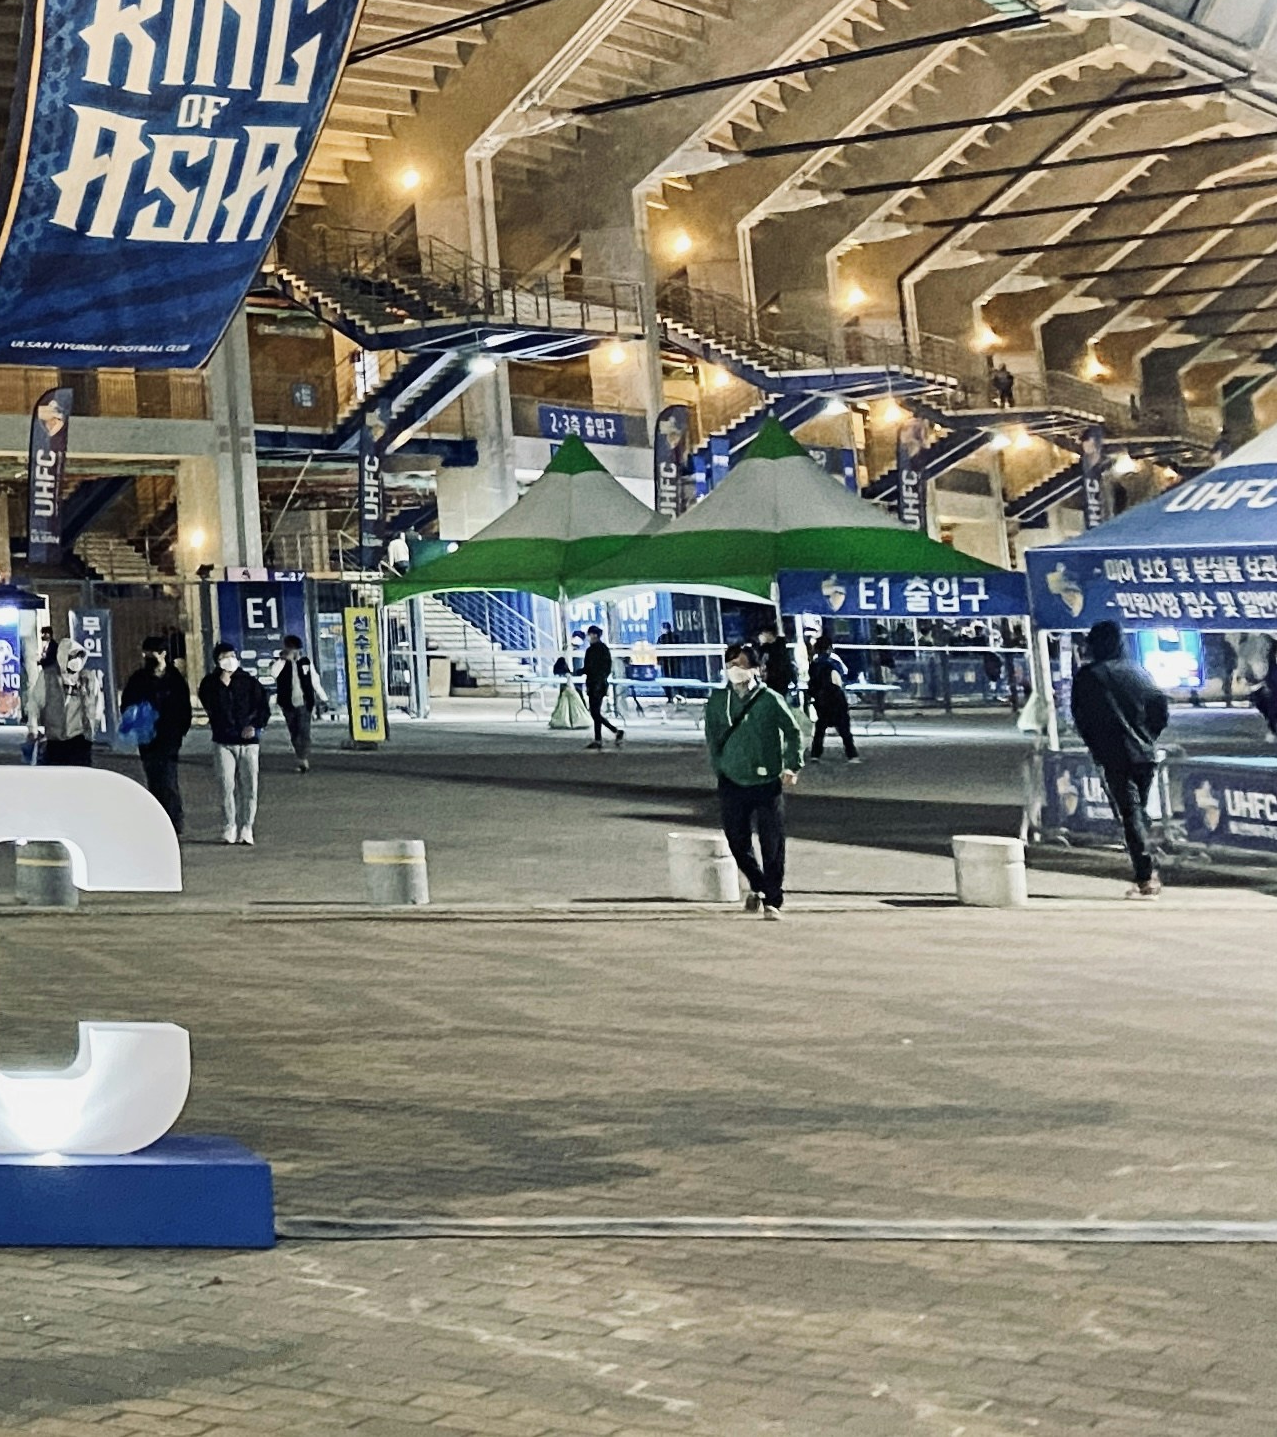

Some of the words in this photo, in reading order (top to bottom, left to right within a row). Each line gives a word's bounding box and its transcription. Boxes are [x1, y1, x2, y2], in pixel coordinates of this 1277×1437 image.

[176, 94, 231, 129] OF
[49, 104, 302, 243] ASIA
[10, 340, 52, 349] ULSAN
[52, 341, 108, 352] HYUNDAI
[108, 343, 164, 353] FOOTBALL
[165, 343, 192, 353] CLUB
[584, 416, 617, 440] 출입구
[33, 449, 57, 518] UHFC
[363, 454, 380, 521] UHFC
[1165, 478, 1277, 513] UHFC
[1138, 556, 1175, 583] 보호
[1192, 555, 1245, 583] 분실물
[858, 577, 892, 612] E1
[903, 575, 990, 614] 출입구
[246, 597, 279, 629] E1
[82, 616, 103, 657] 무인
[353, 614, 374, 688] 선수카드
[358, 695, 380, 732] 구매
[1225, 789, 1277, 822] UHFC
